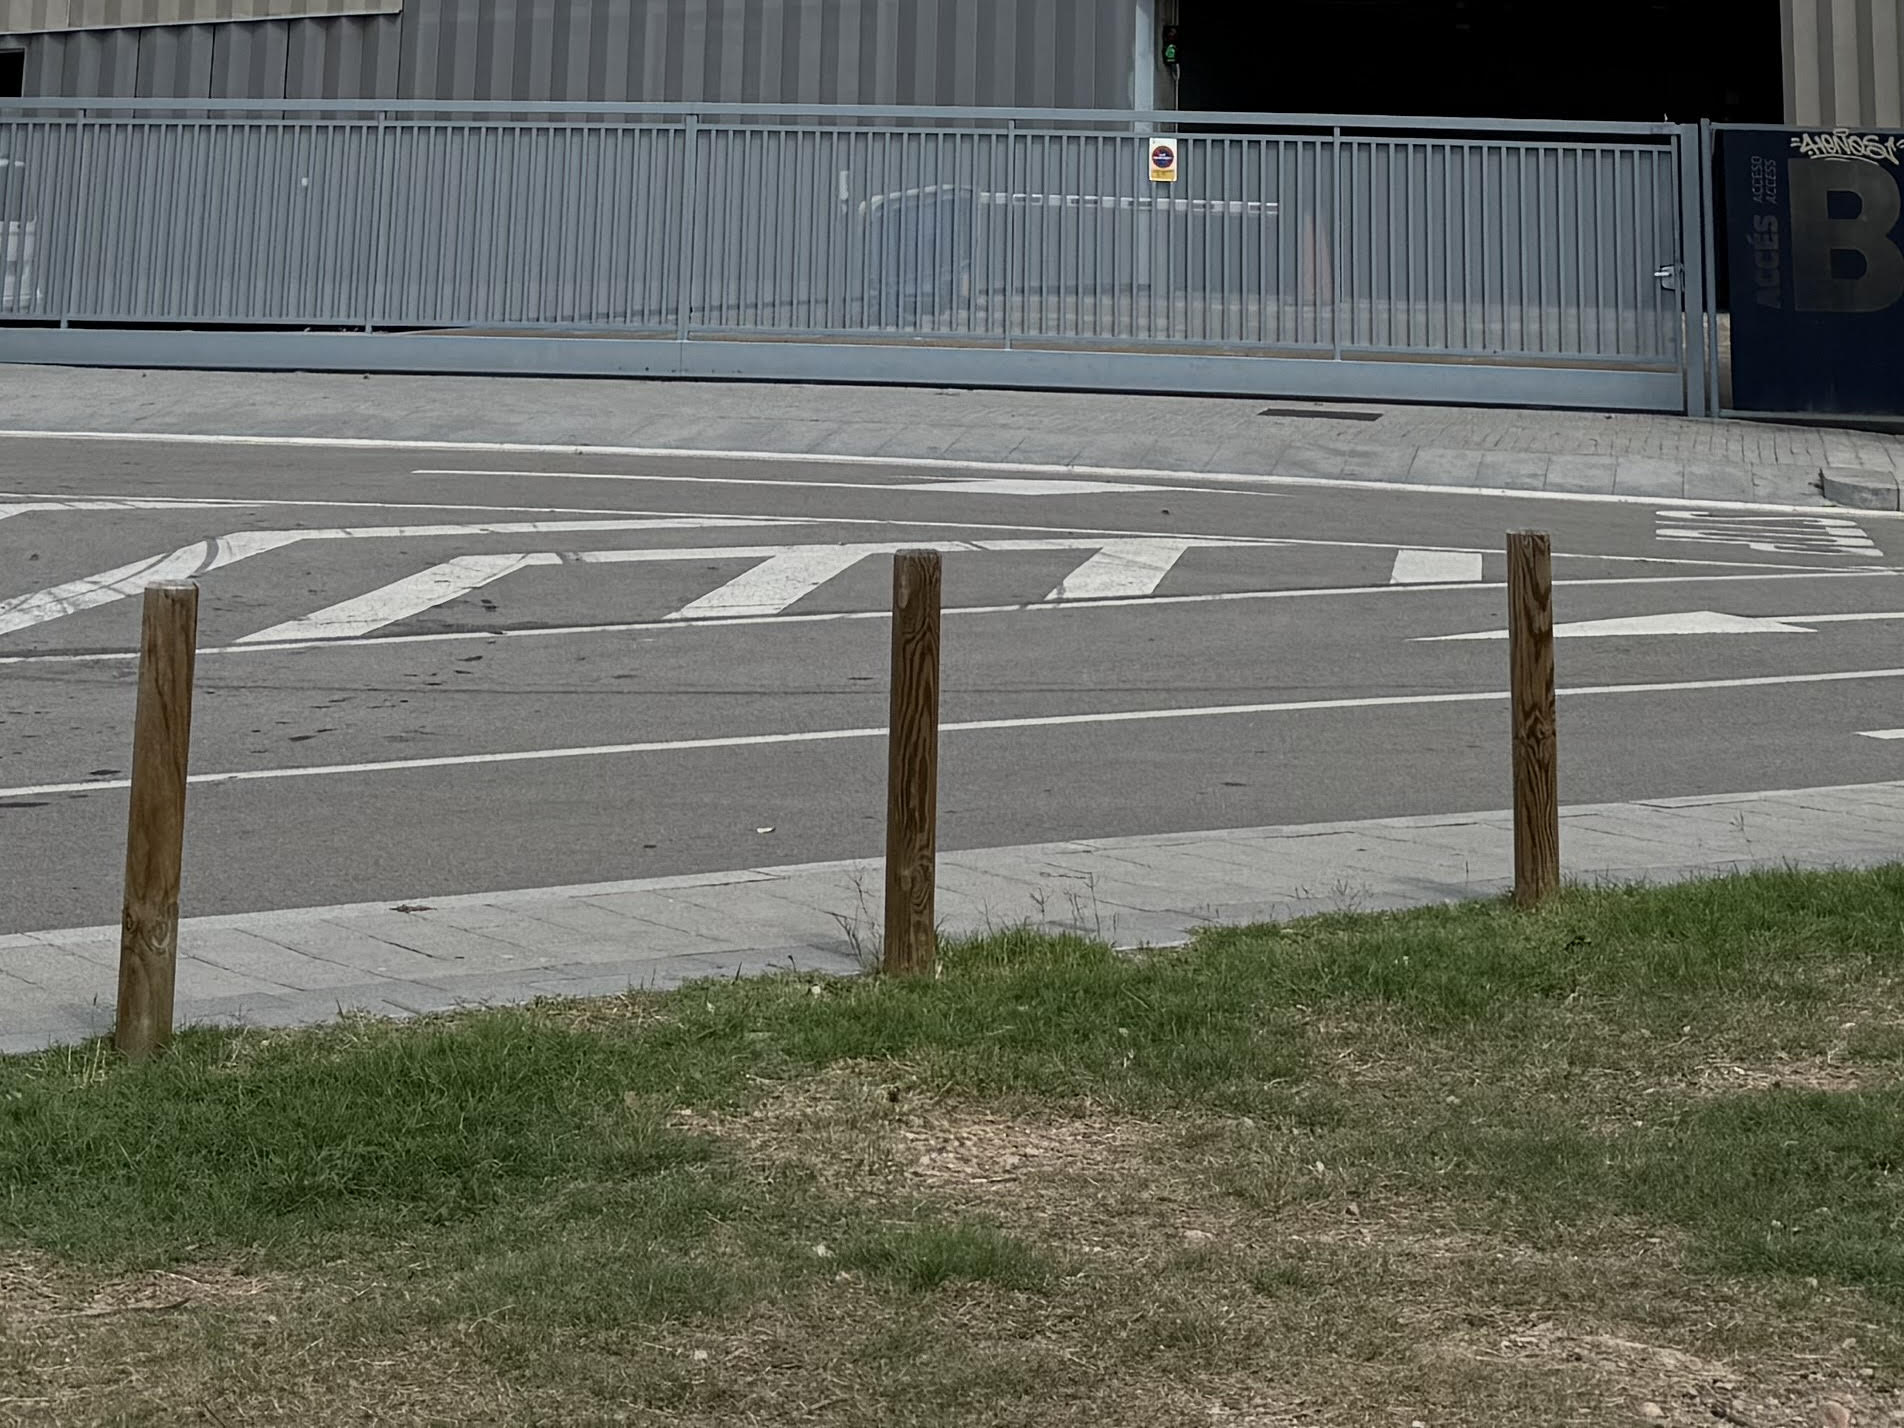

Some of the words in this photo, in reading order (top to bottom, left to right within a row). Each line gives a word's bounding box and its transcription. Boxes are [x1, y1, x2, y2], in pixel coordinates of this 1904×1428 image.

[1751, 156, 1763, 203] ACCESO
[1764, 158, 1777, 205] ACCESS
[1746, 215, 1781, 309] ACCÉS
[1655, 510, 1884, 557] STOP
